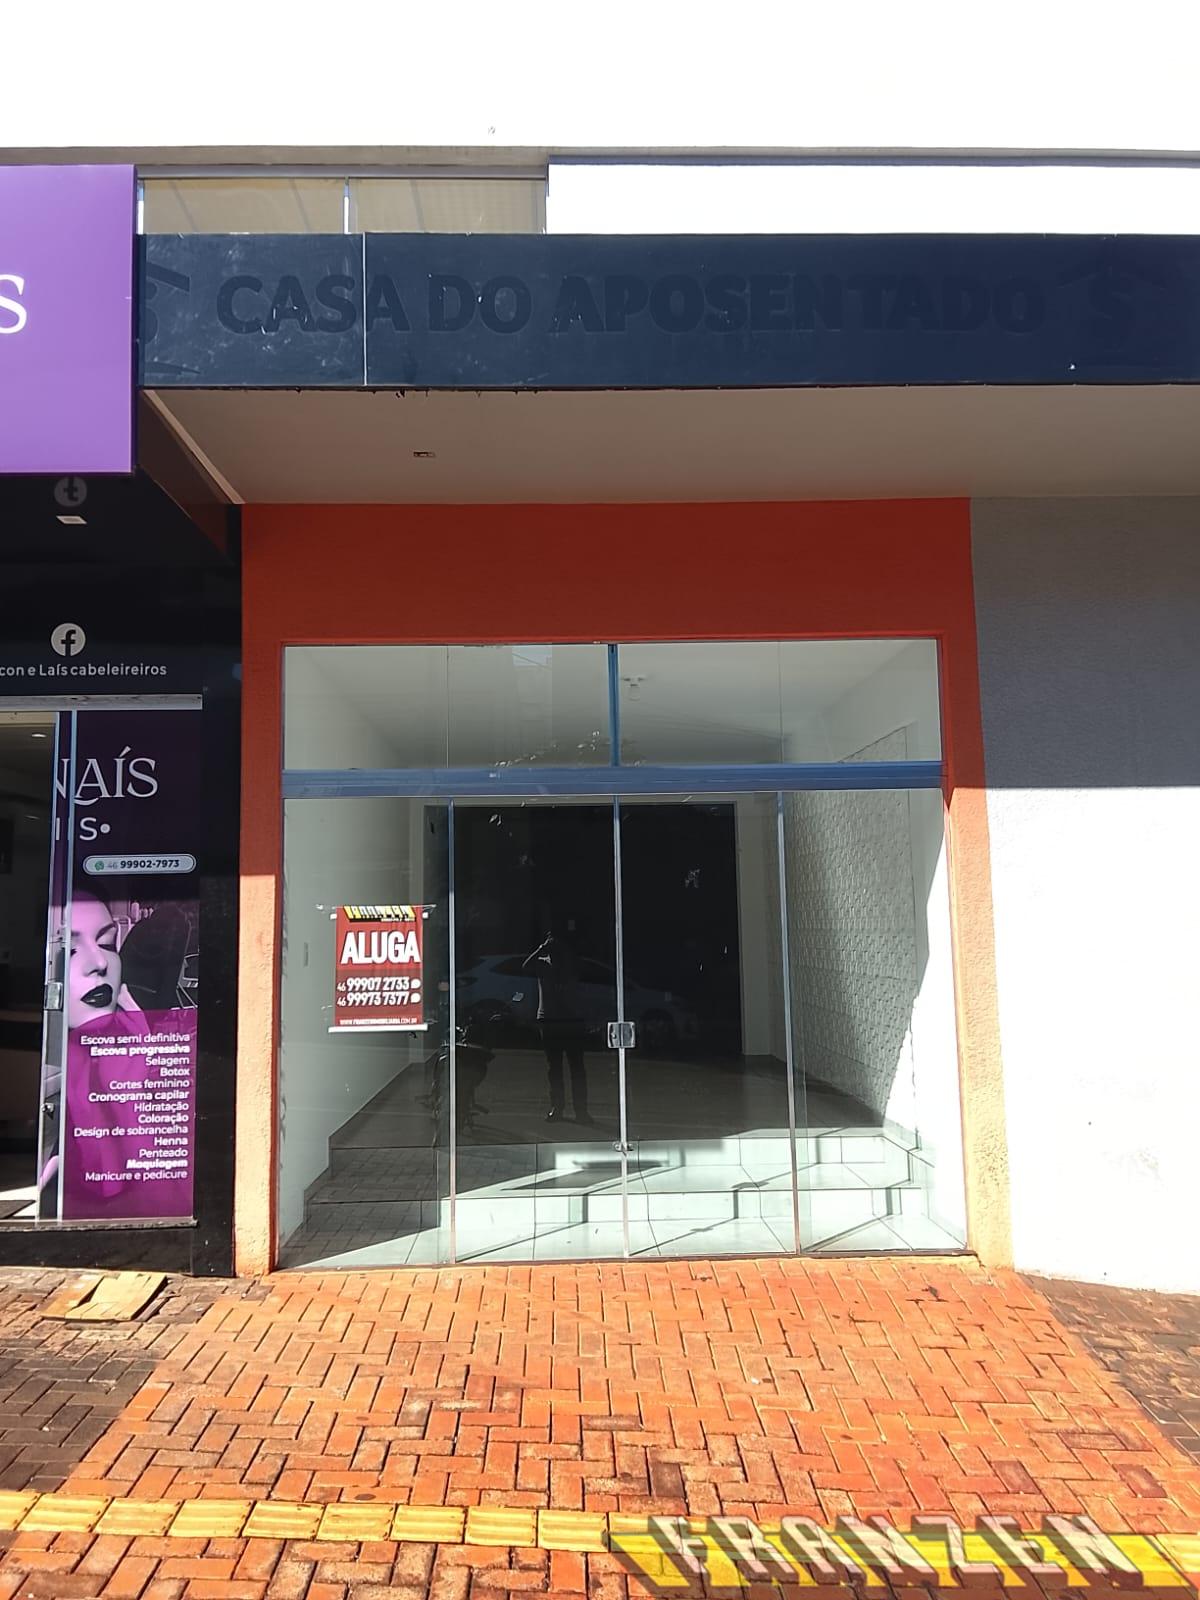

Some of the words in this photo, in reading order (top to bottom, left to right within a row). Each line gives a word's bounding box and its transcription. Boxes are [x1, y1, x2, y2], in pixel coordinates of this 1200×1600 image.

[217, 274, 411, 334] CASA
[429, 275, 531, 334] DO
[549, 274, 1046, 334] APOSENTADO
[27, 666, 36, 676] e
[70, 663, 167, 676] cabeleireiros
[120, 859, 180, 869] 99902-7973
[340, 930, 421, 964] ALUGA
[346, 977, 382, 992] 99907
[80, 1035, 115, 1045] Escova
[116, 1034, 142, 1044] semi
[143, 1032, 190, 1043] definitiva
[90, 1047, 127, 1057] Escova
[129, 1044, 190, 1057] progressiva
[145, 1056, 190, 1067] Selagem
[159, 1067, 190, 1077] Botox
[109, 1081, 142, 1090] Cortes
[144, 1079, 190, 1089] feminino
[88, 1092, 152, 1104] Cronograma
[154, 1090, 190, 1101] capilar
[133, 1102, 189, 1114] Hidratação
[138, 1113, 189, 1125] Coloração
[74, 1127, 109, 1138] Design
[111, 1126, 126, 1136] de
[127, 1124, 188, 1136] sobrancelha
[154, 1137, 188, 1146] Henna
[139, 1148, 188, 1158] Penteado
[85, 1172, 133, 1182] Manicure
[134, 1172, 142, 1180] e
[143, 1170, 188, 1181] pedicure
